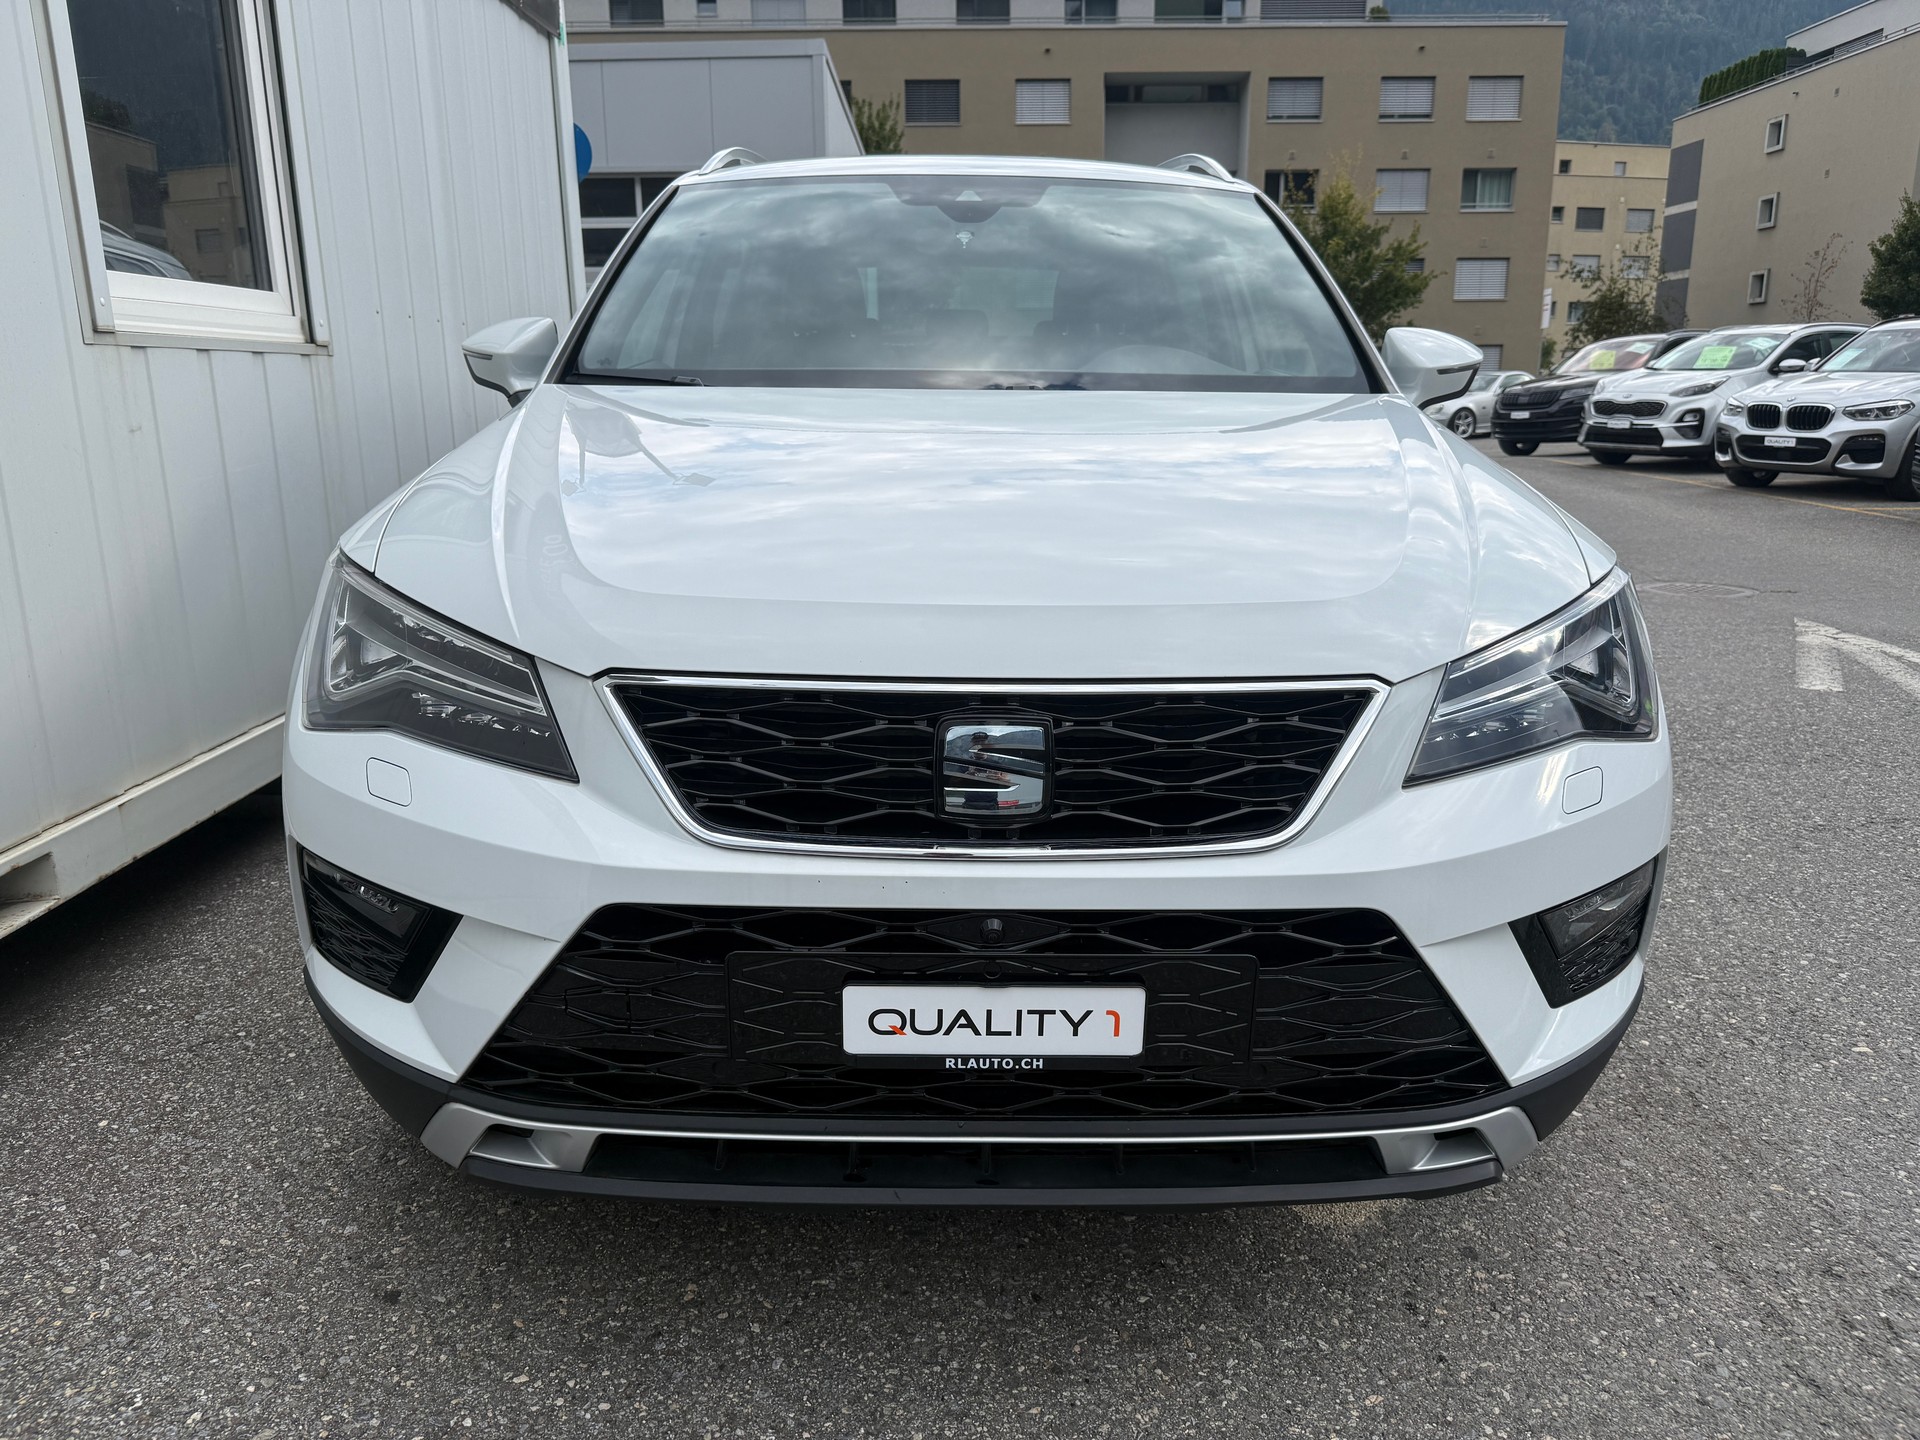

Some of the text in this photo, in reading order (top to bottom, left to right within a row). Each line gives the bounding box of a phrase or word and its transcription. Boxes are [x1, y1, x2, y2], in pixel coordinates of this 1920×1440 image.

[868, 1008, 1121, 1037] QUALITY 1
[945, 1057, 1044, 1069] RLAUTO.CH
